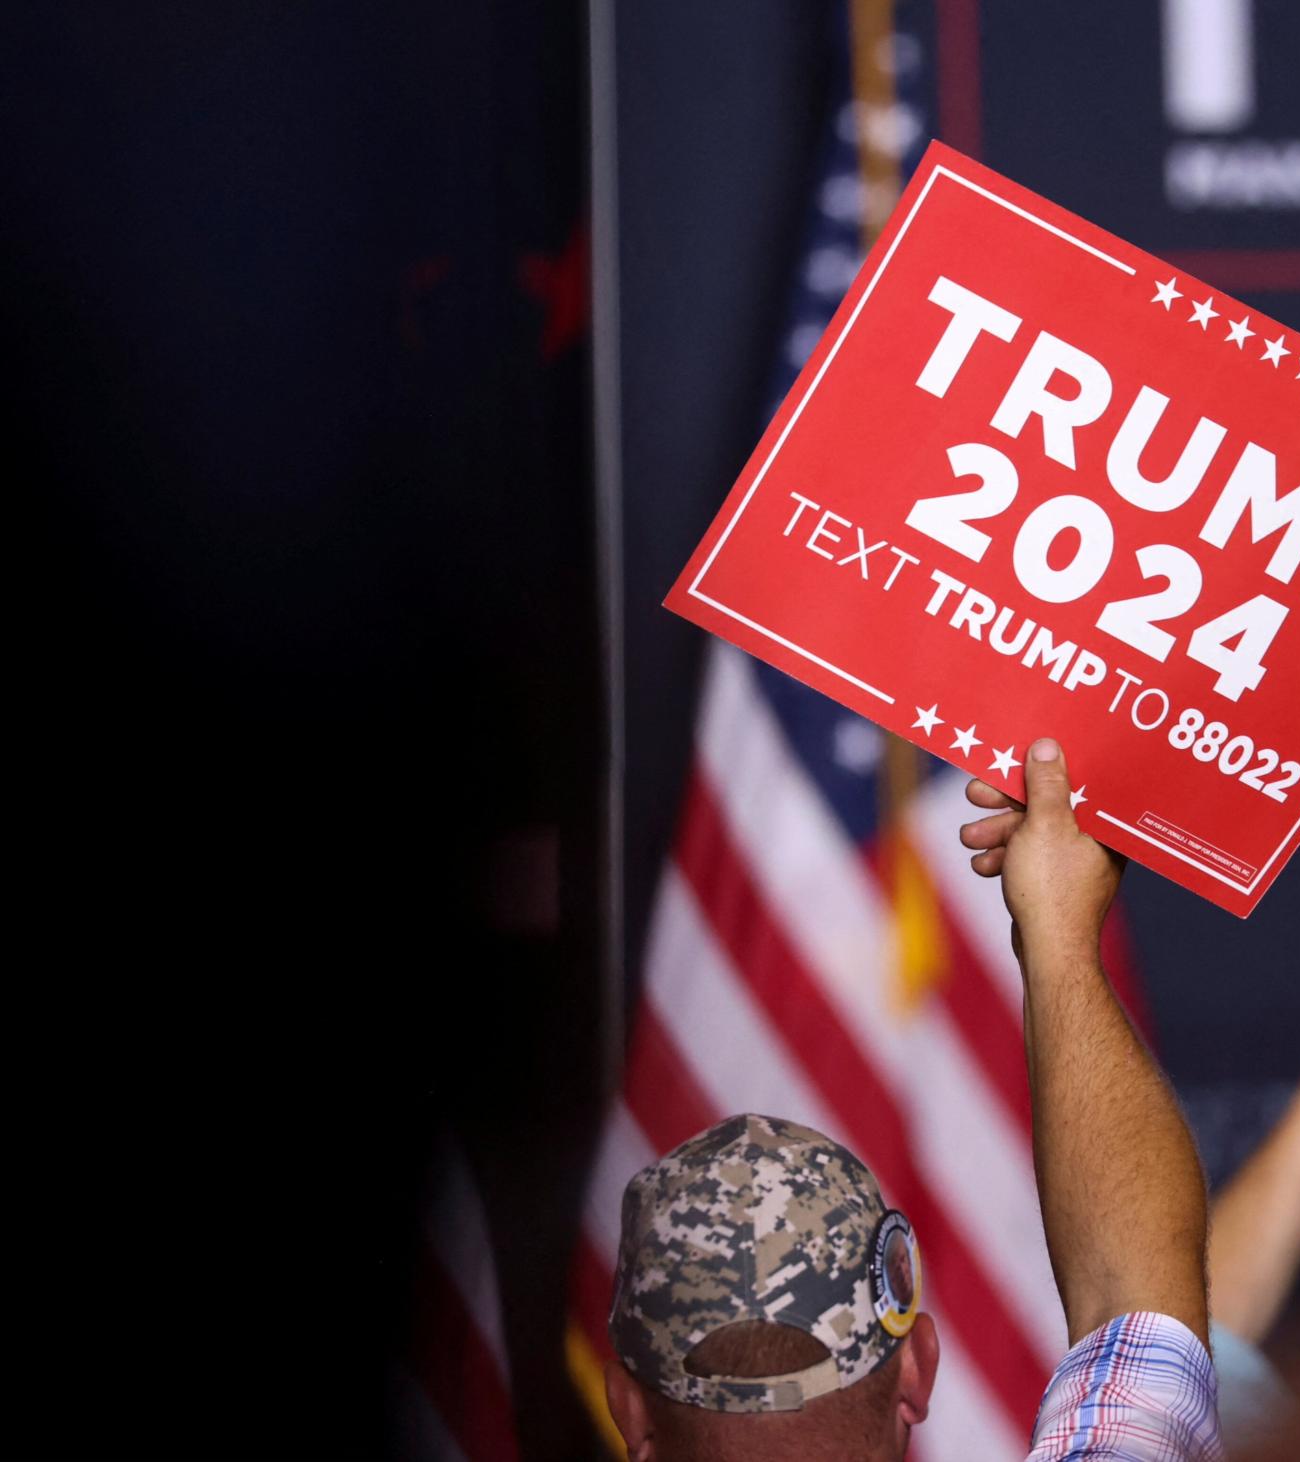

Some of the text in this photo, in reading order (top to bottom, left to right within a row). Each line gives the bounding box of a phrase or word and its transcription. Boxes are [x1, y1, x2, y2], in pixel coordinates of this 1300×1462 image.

[784, 492, 920, 592] TEXT
[924, 569, 1106, 692] TRUMP
[1109, 668, 1170, 731] TO
[905, 443, 1289, 701] 2024
